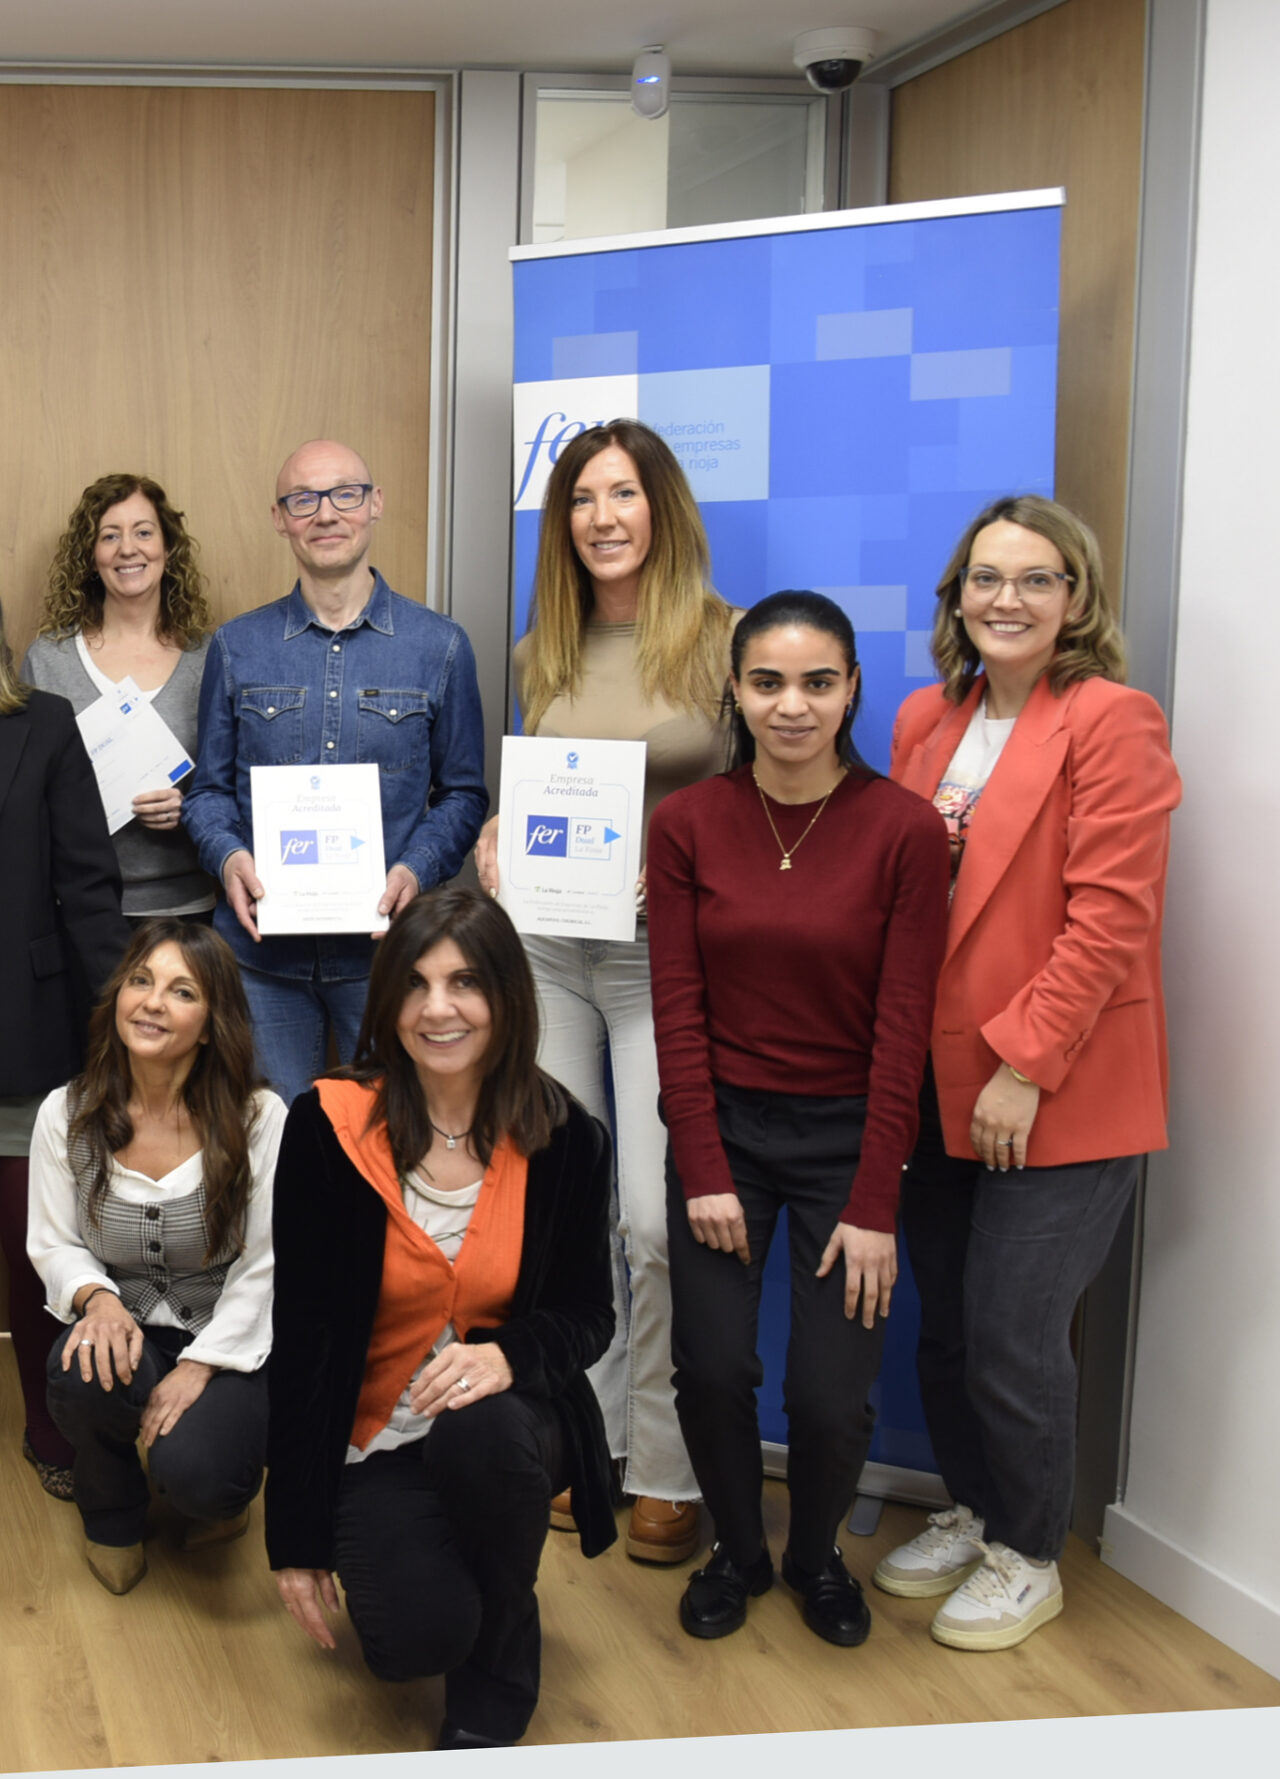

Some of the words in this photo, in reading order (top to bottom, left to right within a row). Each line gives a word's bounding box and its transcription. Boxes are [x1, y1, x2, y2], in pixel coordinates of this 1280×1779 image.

[654, 420, 724, 437] federación
[673, 439, 742, 453] empresas
[514, 411, 606, 506] fe
[549, 773, 595, 786] Empresa
[543, 785, 600, 798] Acreditada
[575, 824, 592, 836] FP
[324, 835, 340, 844] FP
[525, 824, 565, 856] fer
[280, 838, 316, 866] fer
